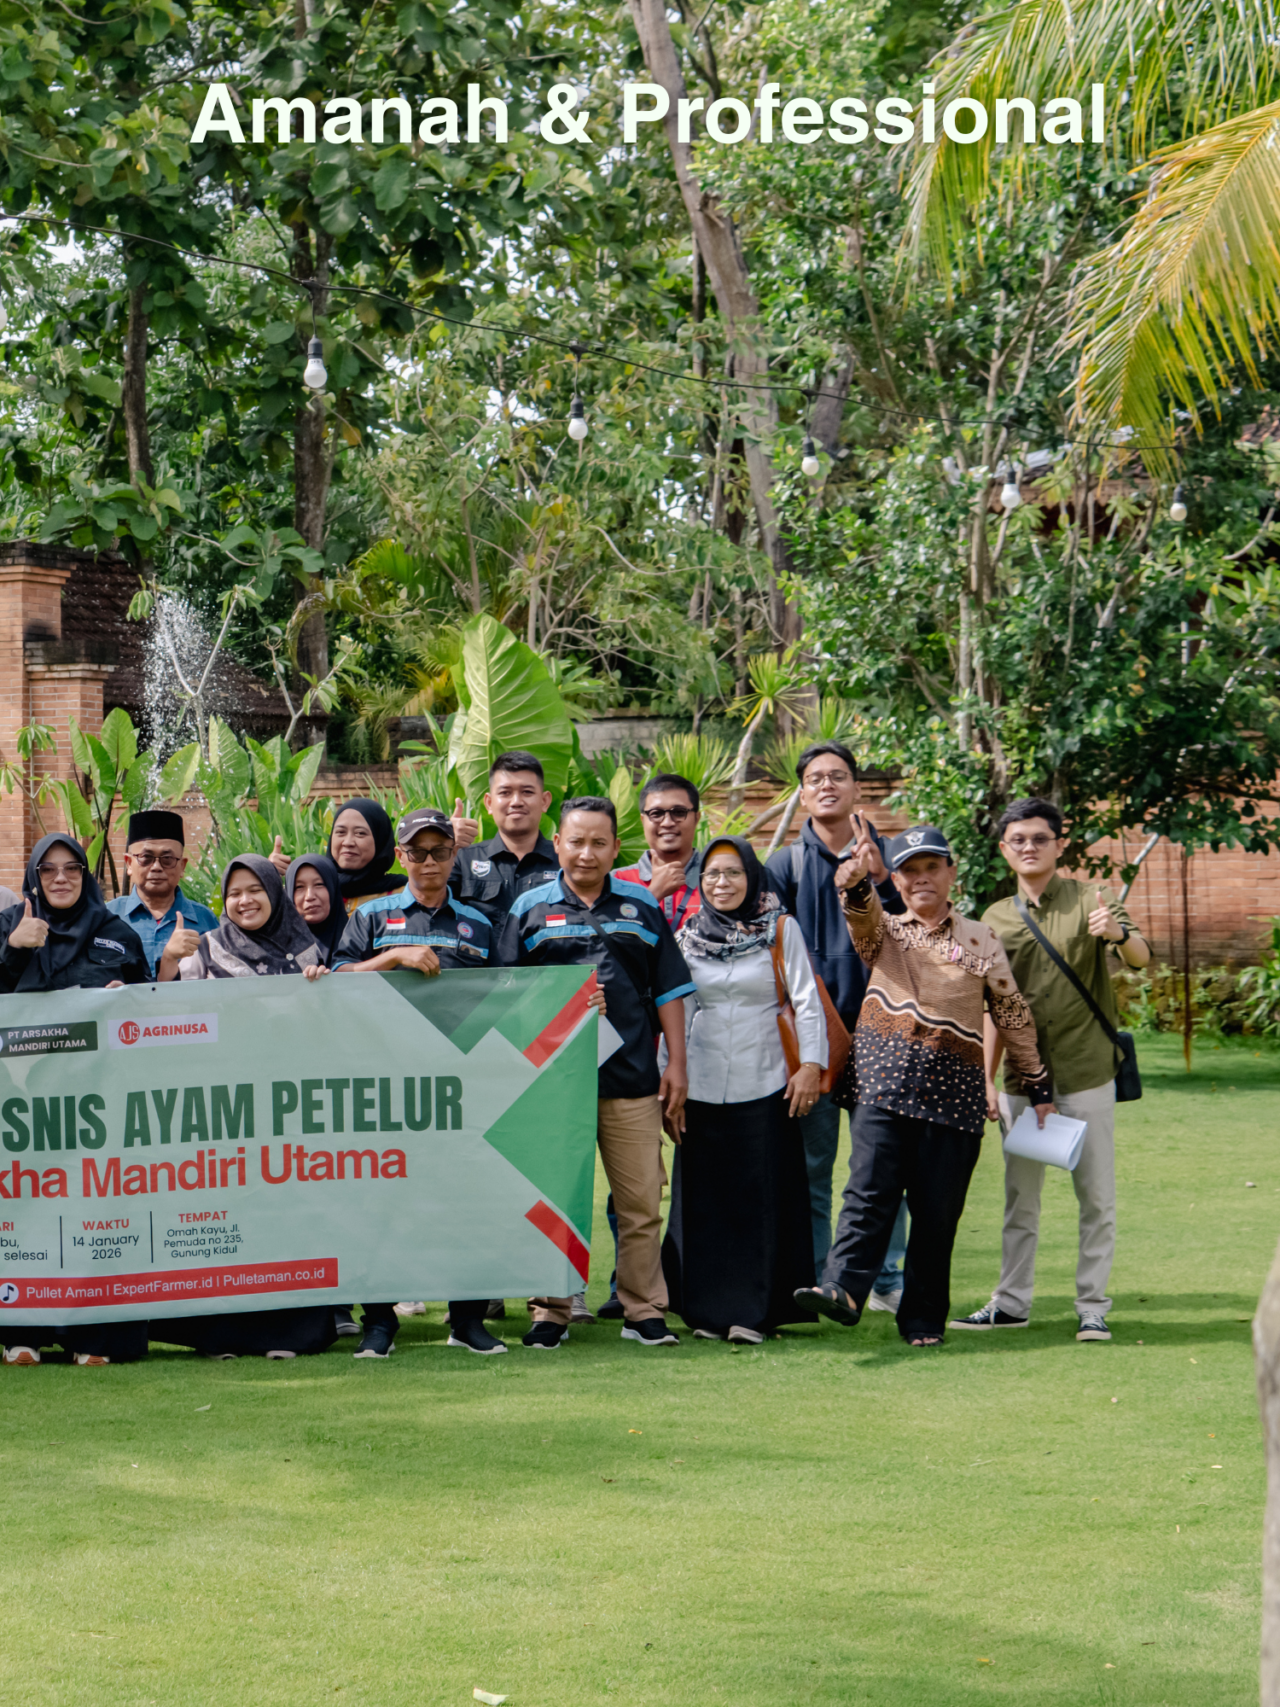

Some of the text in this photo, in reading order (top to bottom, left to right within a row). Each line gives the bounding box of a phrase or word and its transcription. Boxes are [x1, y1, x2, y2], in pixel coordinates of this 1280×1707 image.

[7, 1028, 69, 1040] PT ARSAKHA
[119, 1023, 209, 1041] AJS AGRINUSA
[8, 1039, 87, 1053] MANDIRI UTAMA
[124, 1083, 254, 1148] AYAM
[272, 1076, 462, 1136] PETELUR
[82, 1147, 246, 1197] Mandiri
[261, 1144, 407, 1184] Utama
[179, 1211, 227, 1223] TEMPAT
[83, 1219, 129, 1230] WAKTU
[166, 1223, 240, 1238] Omah Kayu, Jl.
[72, 1234, 140, 1248] 14 January
[163, 1234, 244, 1249] Pemuda no 235,
[4, 1250, 47, 1260] selesai
[92, 1248, 121, 1259] 2026
[170, 1244, 238, 1260] Gunung Kidul
[27, 1287, 61, 1298] Pullet
[65, 1287, 102, 1298] Aman
[113, 1277, 214, 1299] ExpertFarmer.id
[223, 1267, 325, 1289] Pulletaman.co.id
